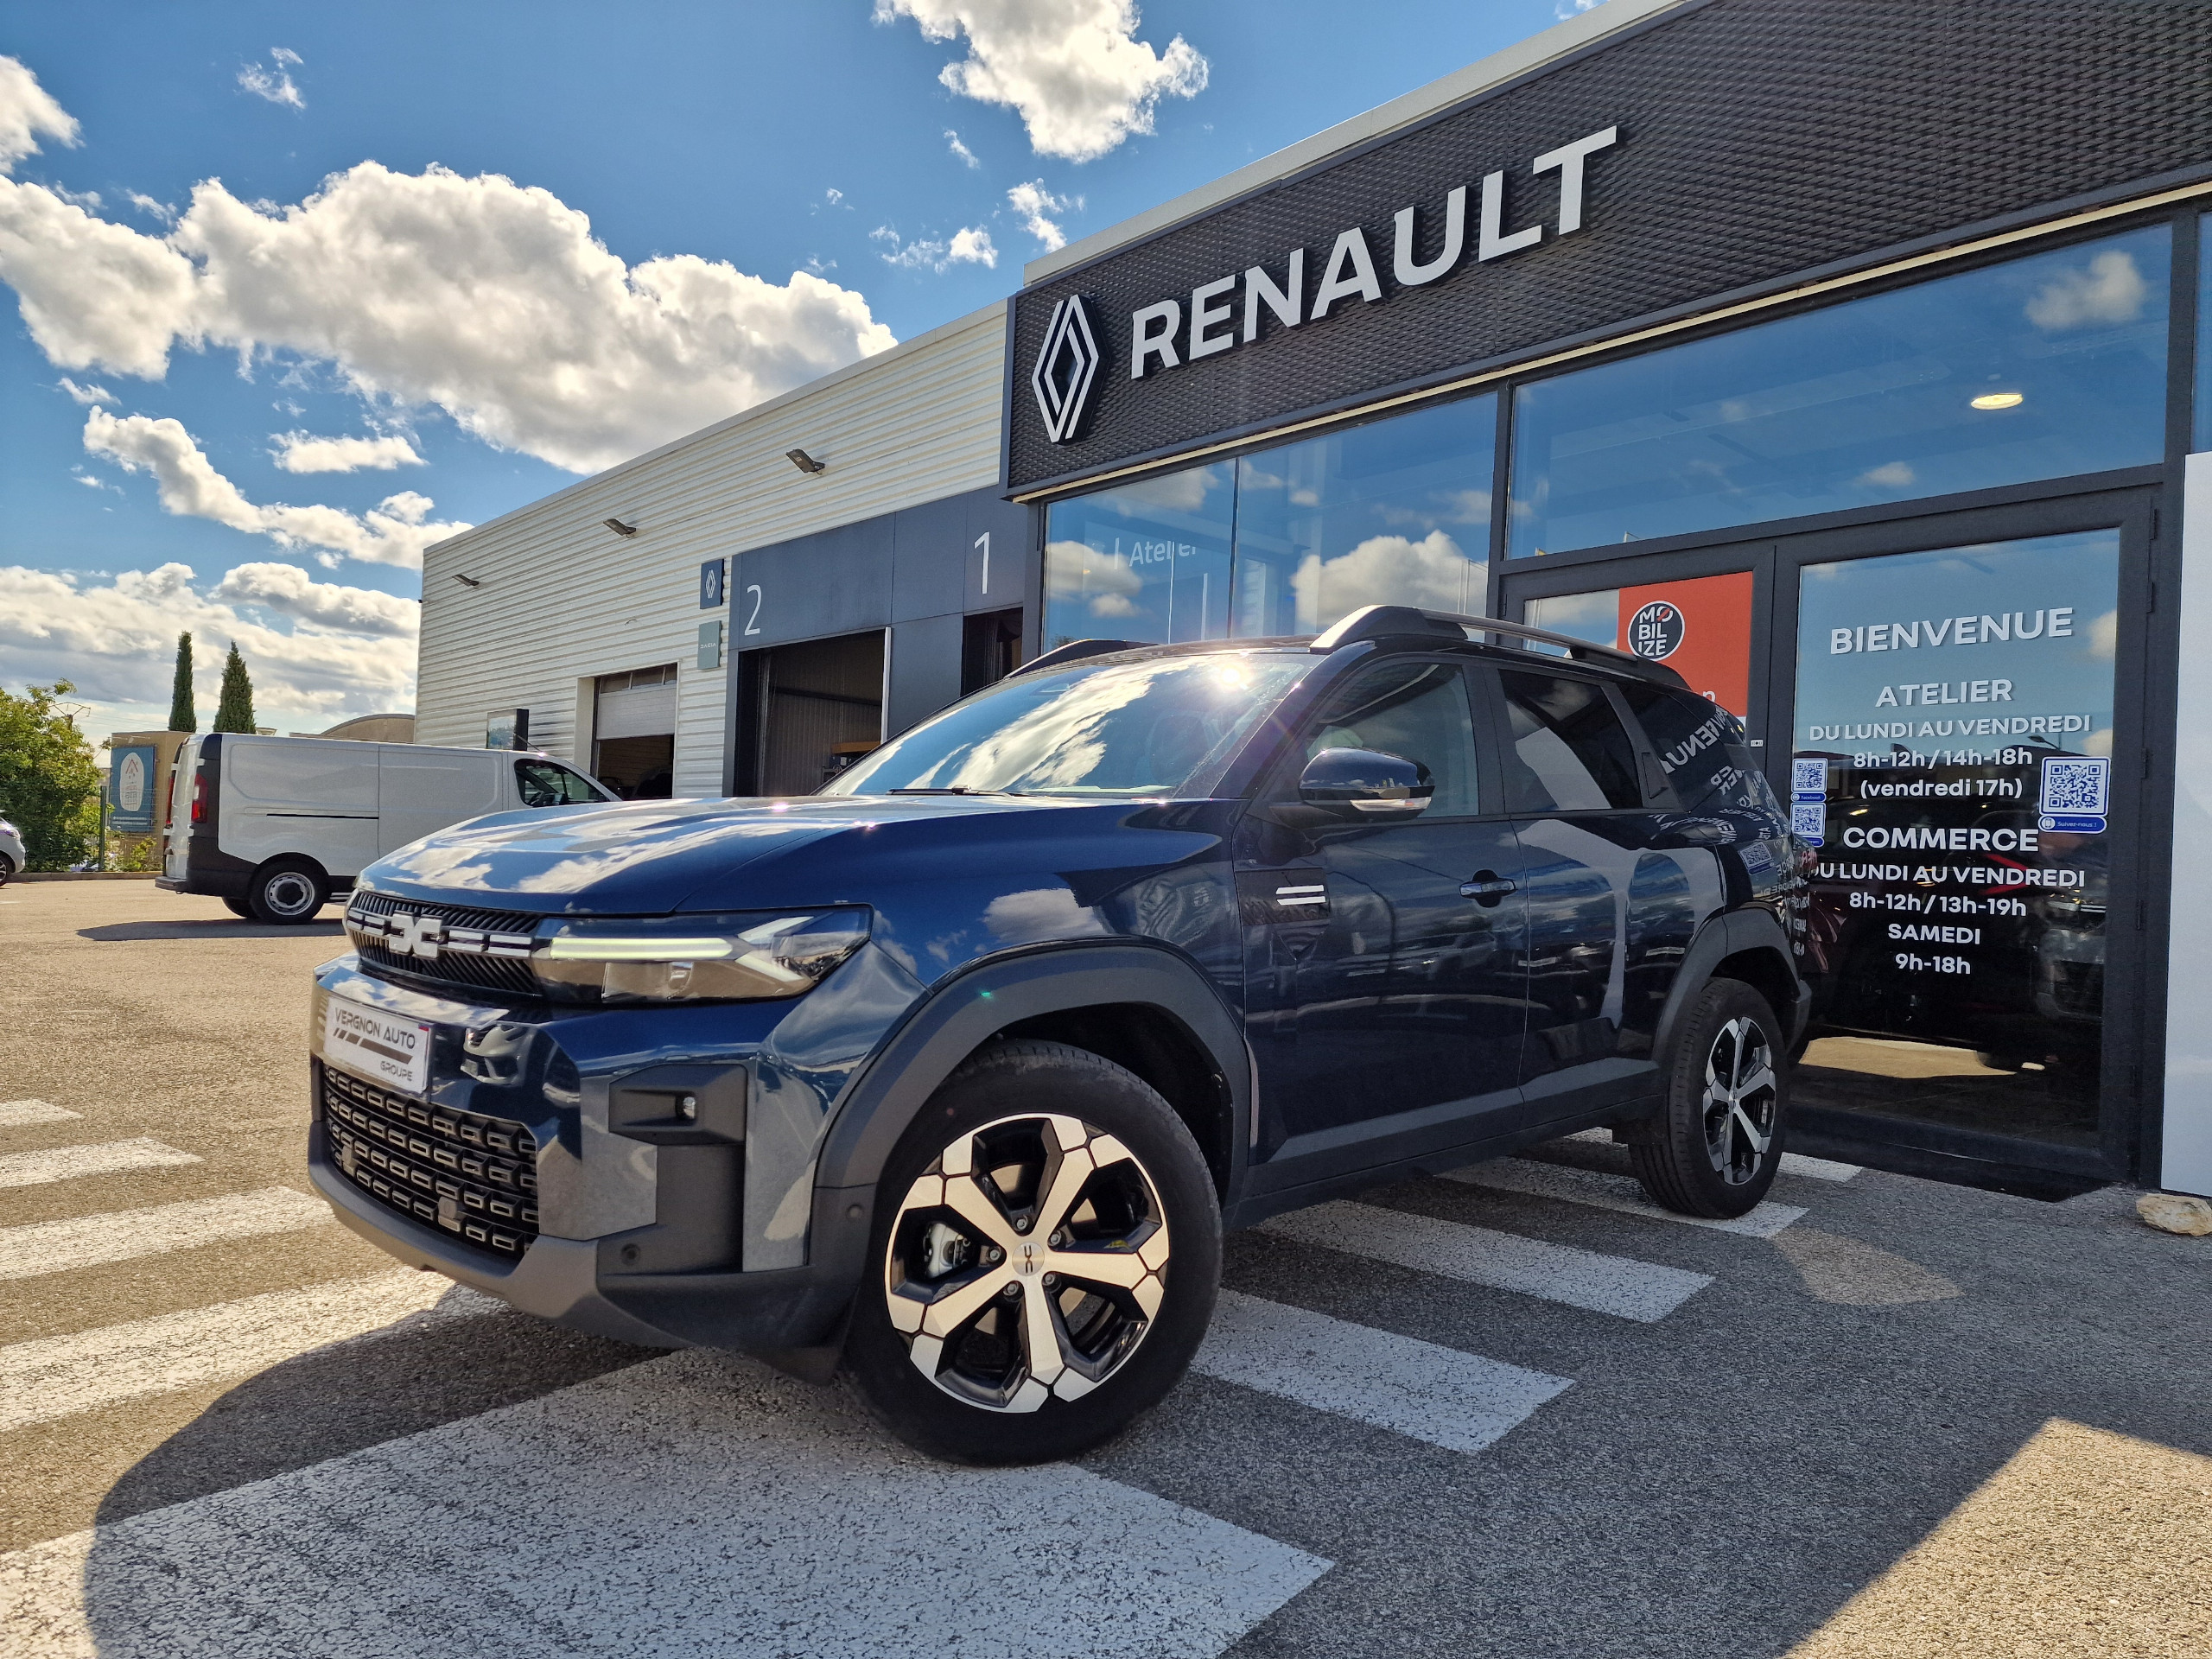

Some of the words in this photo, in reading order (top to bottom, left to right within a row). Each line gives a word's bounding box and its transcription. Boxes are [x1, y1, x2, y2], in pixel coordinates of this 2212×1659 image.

[1131, 125, 1618, 380] RENAULT
[974, 531, 990, 594] 1
[744, 584, 762, 636] 2
[1830, 607, 2074, 655] BIENVENUE
[1875, 678, 2013, 708] ATELIER
[1810, 725, 1840, 741] DU
[1845, 721, 1913, 740] LUNDI
[1918, 719, 1953, 737] AU
[1958, 714, 2091, 735] VENDREDI
[1853, 751, 1926, 768] 8h-12h
[1944, 747, 2033, 766] 14h-18h
[1860, 778, 1971, 800] (vendredi
[1976, 777, 2024, 799] 17h)
[1843, 827, 2039, 852] COMMERCE
[1815, 862, 1834, 879] U
[1840, 864, 1909, 881] LUNDI
[1913, 867, 1948, 883] AU
[1953, 867, 2085, 887] VENDREDI
[1849, 892, 1921, 912] 8h-12h
[1940, 895, 2027, 916] 13h-19h
[1888, 923, 1980, 944] SAMEDI
[1895, 953, 1971, 975] 9h-18h
[334, 1007, 381, 1037] VERGNON
[383, 1027, 416, 1049] AUTO
[380, 1060, 413, 1082] GROUPE
